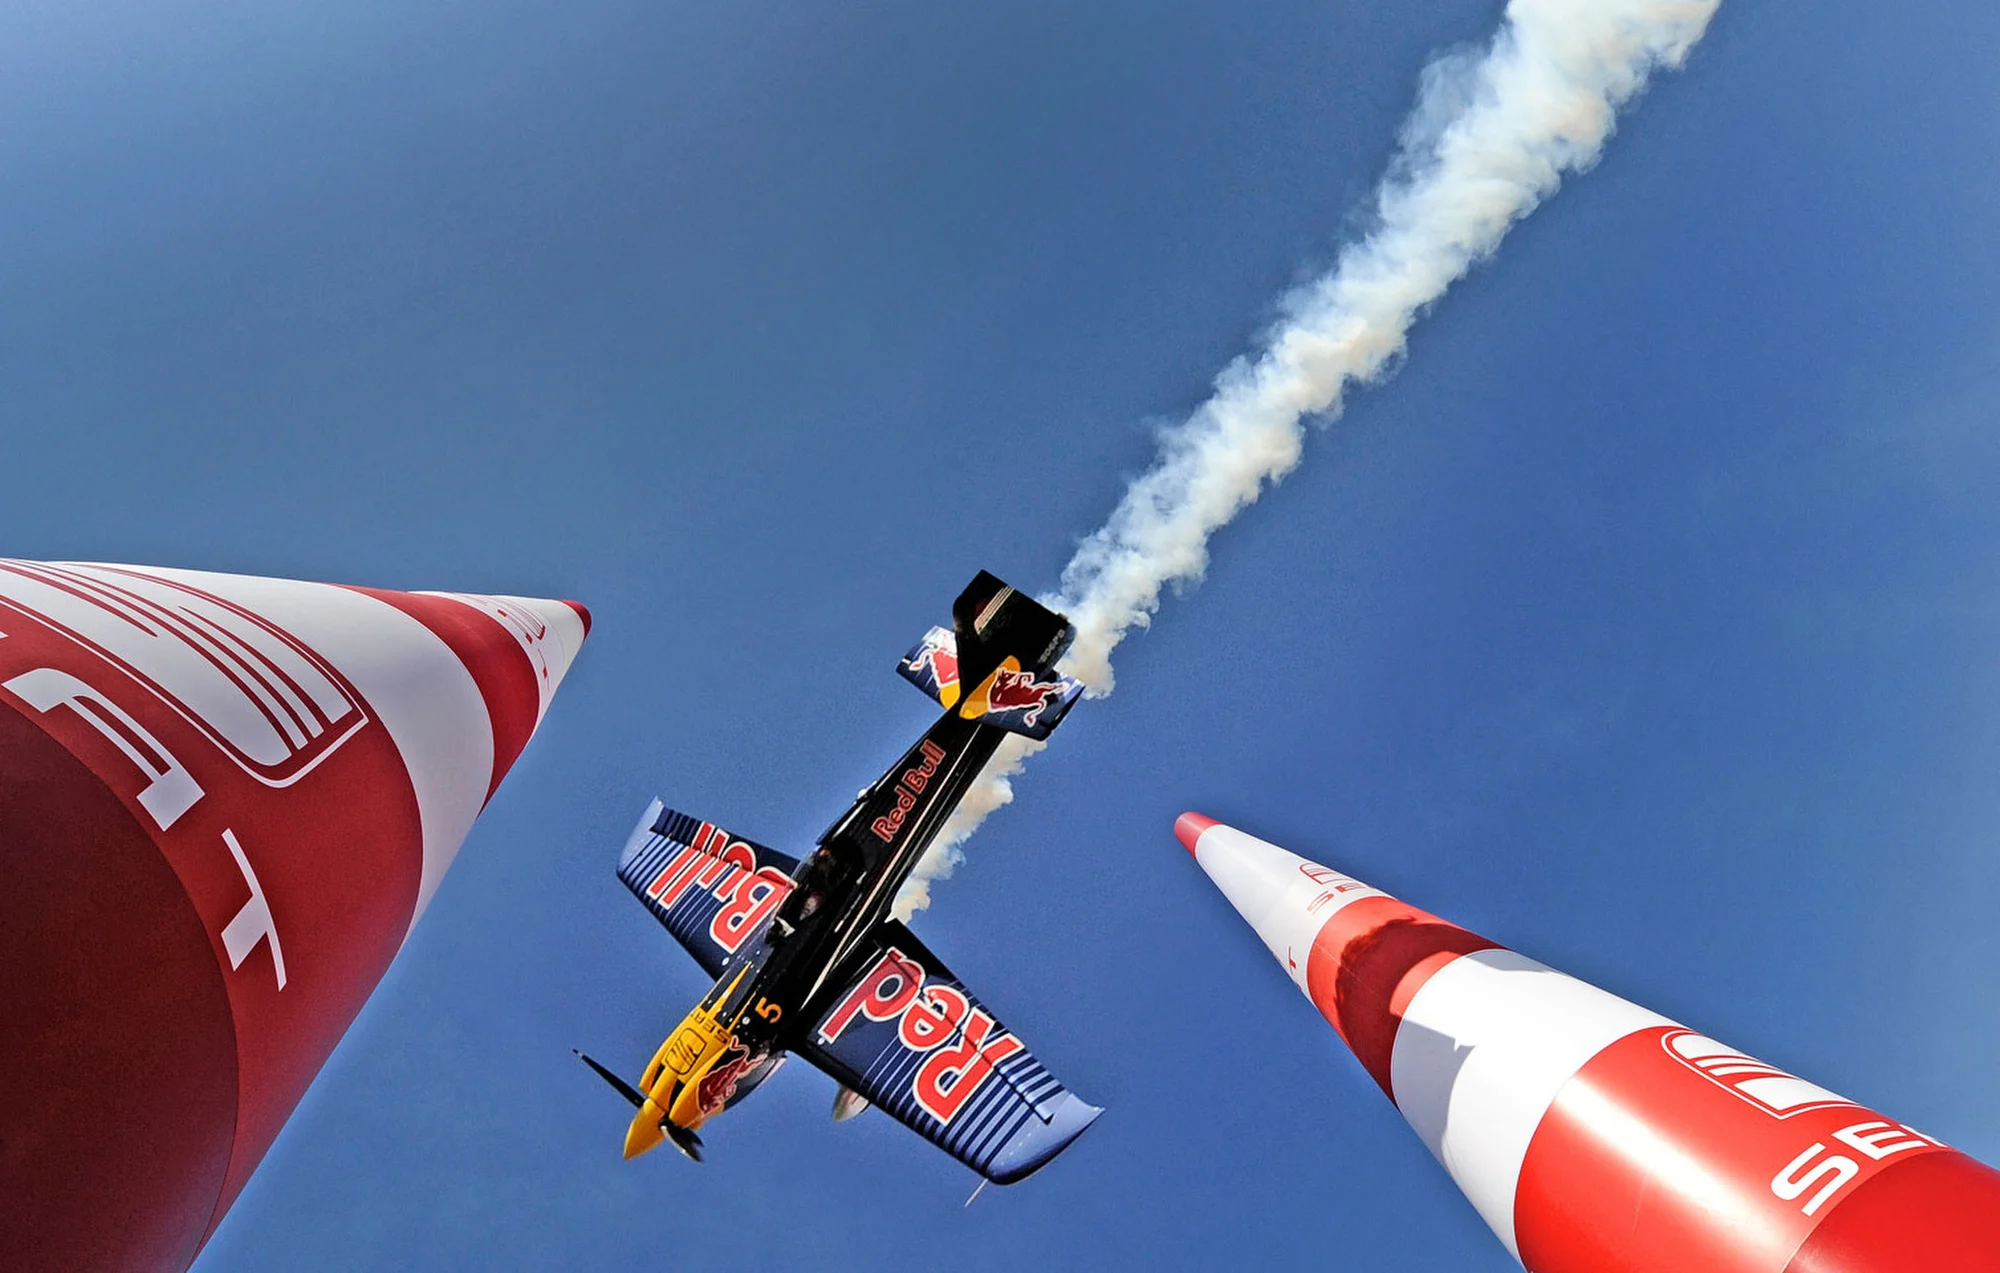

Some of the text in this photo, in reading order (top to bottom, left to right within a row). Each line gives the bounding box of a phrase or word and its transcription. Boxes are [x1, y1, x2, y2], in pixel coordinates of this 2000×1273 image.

[871, 738, 946, 843] Red Bull
[646, 820, 1025, 1127] Red Bull
[755, 996, 782, 1024] 5
